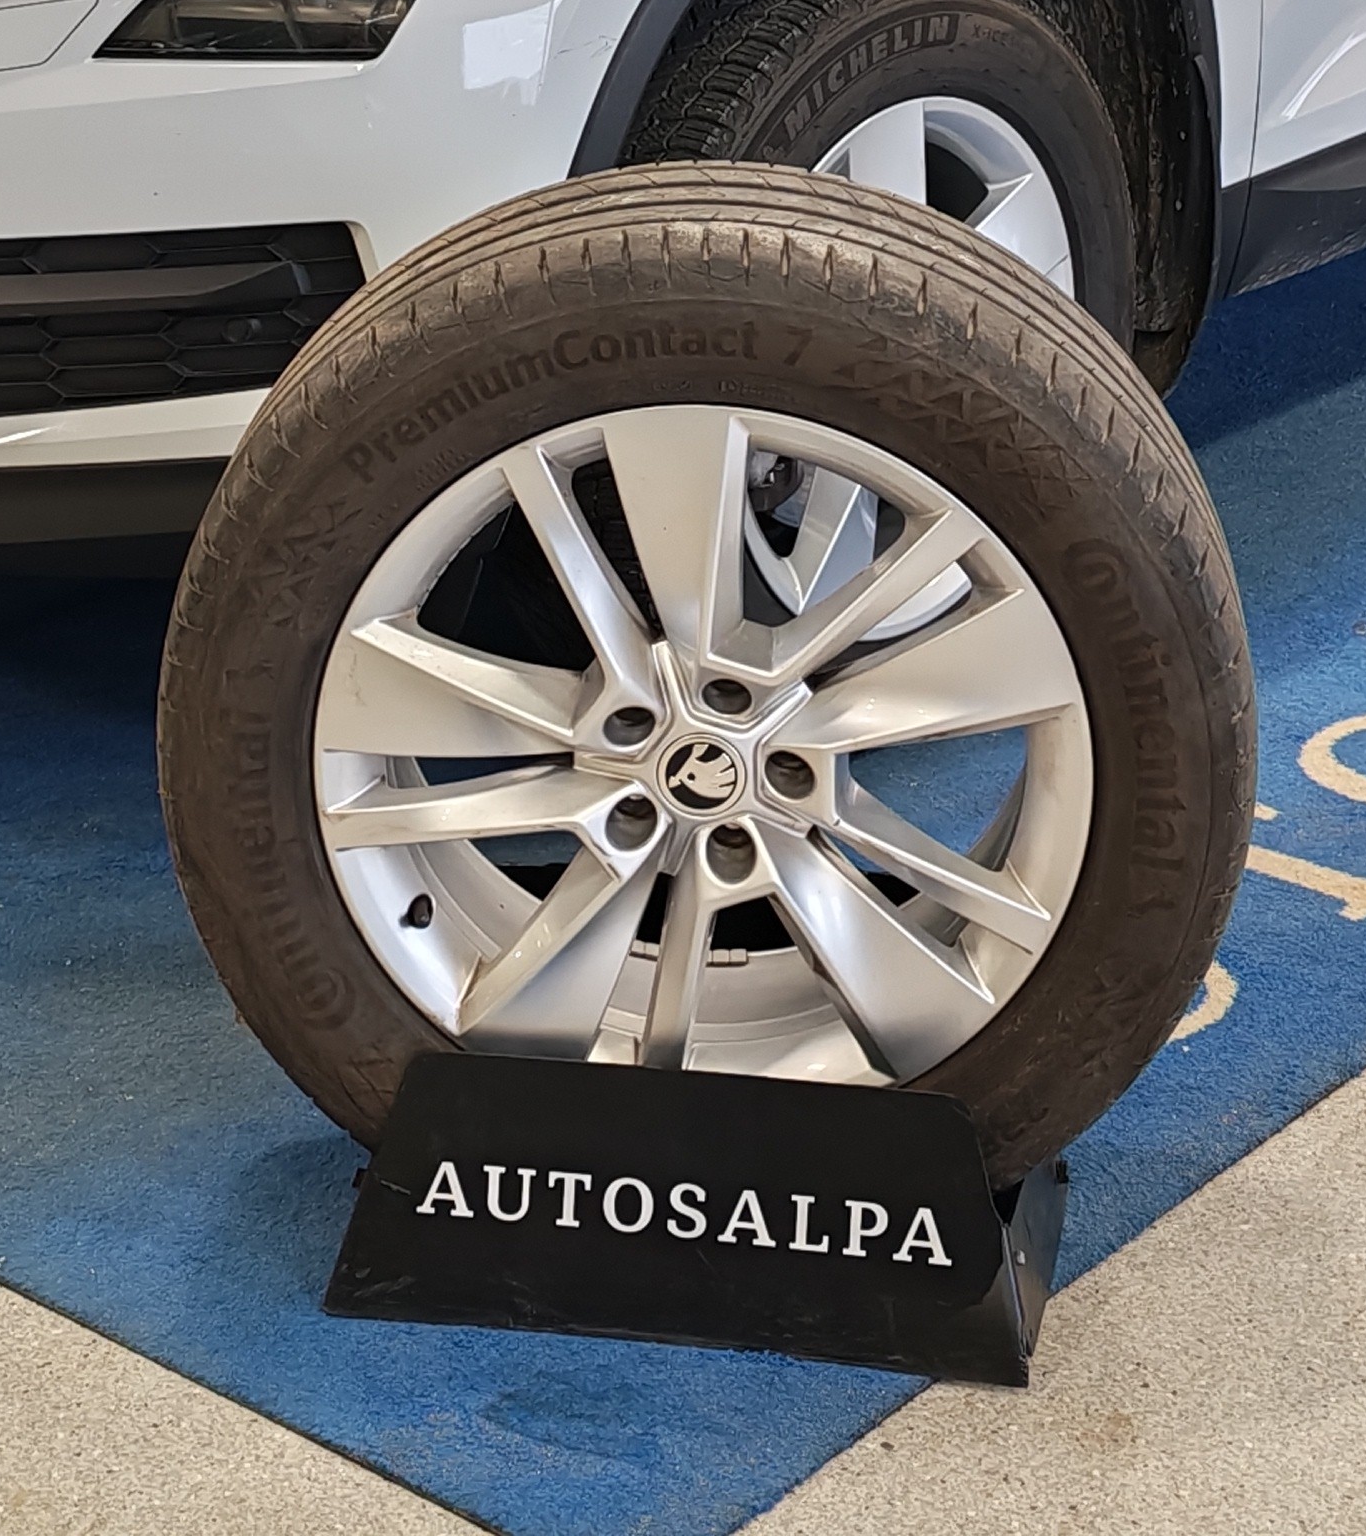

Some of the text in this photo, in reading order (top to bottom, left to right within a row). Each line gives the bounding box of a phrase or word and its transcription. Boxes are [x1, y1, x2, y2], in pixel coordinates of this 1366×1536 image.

[784, 15, 951, 138] MICHELIN
[341, 320, 758, 485] PremiumContact
[782, 326, 814, 367] 7
[415, 1160, 953, 1267] AUTOSALPA
